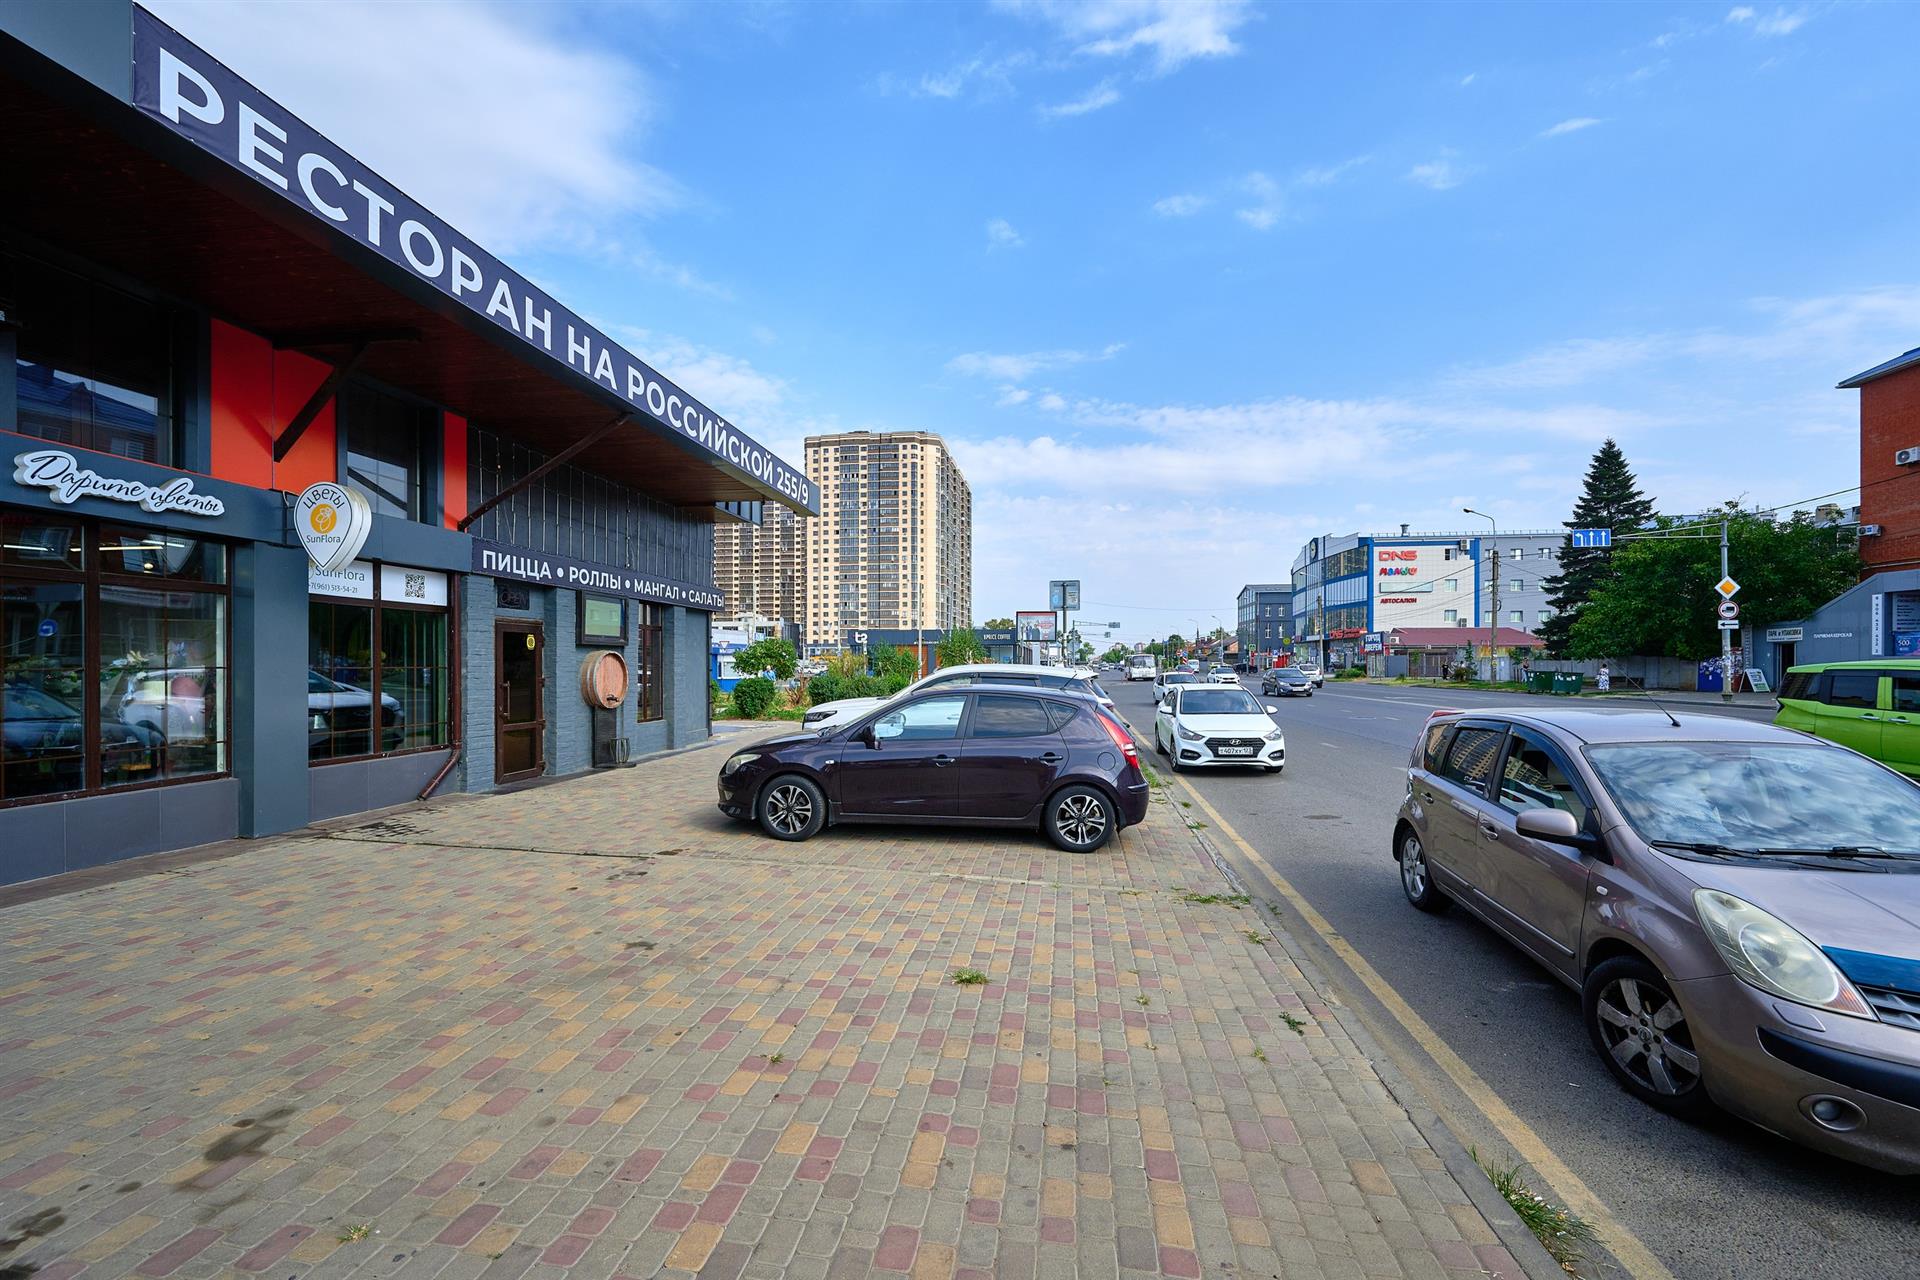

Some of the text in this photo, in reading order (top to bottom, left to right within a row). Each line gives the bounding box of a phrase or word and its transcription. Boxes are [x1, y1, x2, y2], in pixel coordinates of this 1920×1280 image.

[159, 47, 809, 505] РЕСТОРАН НА РОССИЙСКОЙ 255/9
[30, 455, 220, 508] Дарите цветы
[306, 534, 341, 544] SunFlora
[1379, 550, 1417, 561] DNS
[482, 550, 725, 607] ПИЦЦА РОЛЛЫ МАНГАЛ САЛАТЫ
